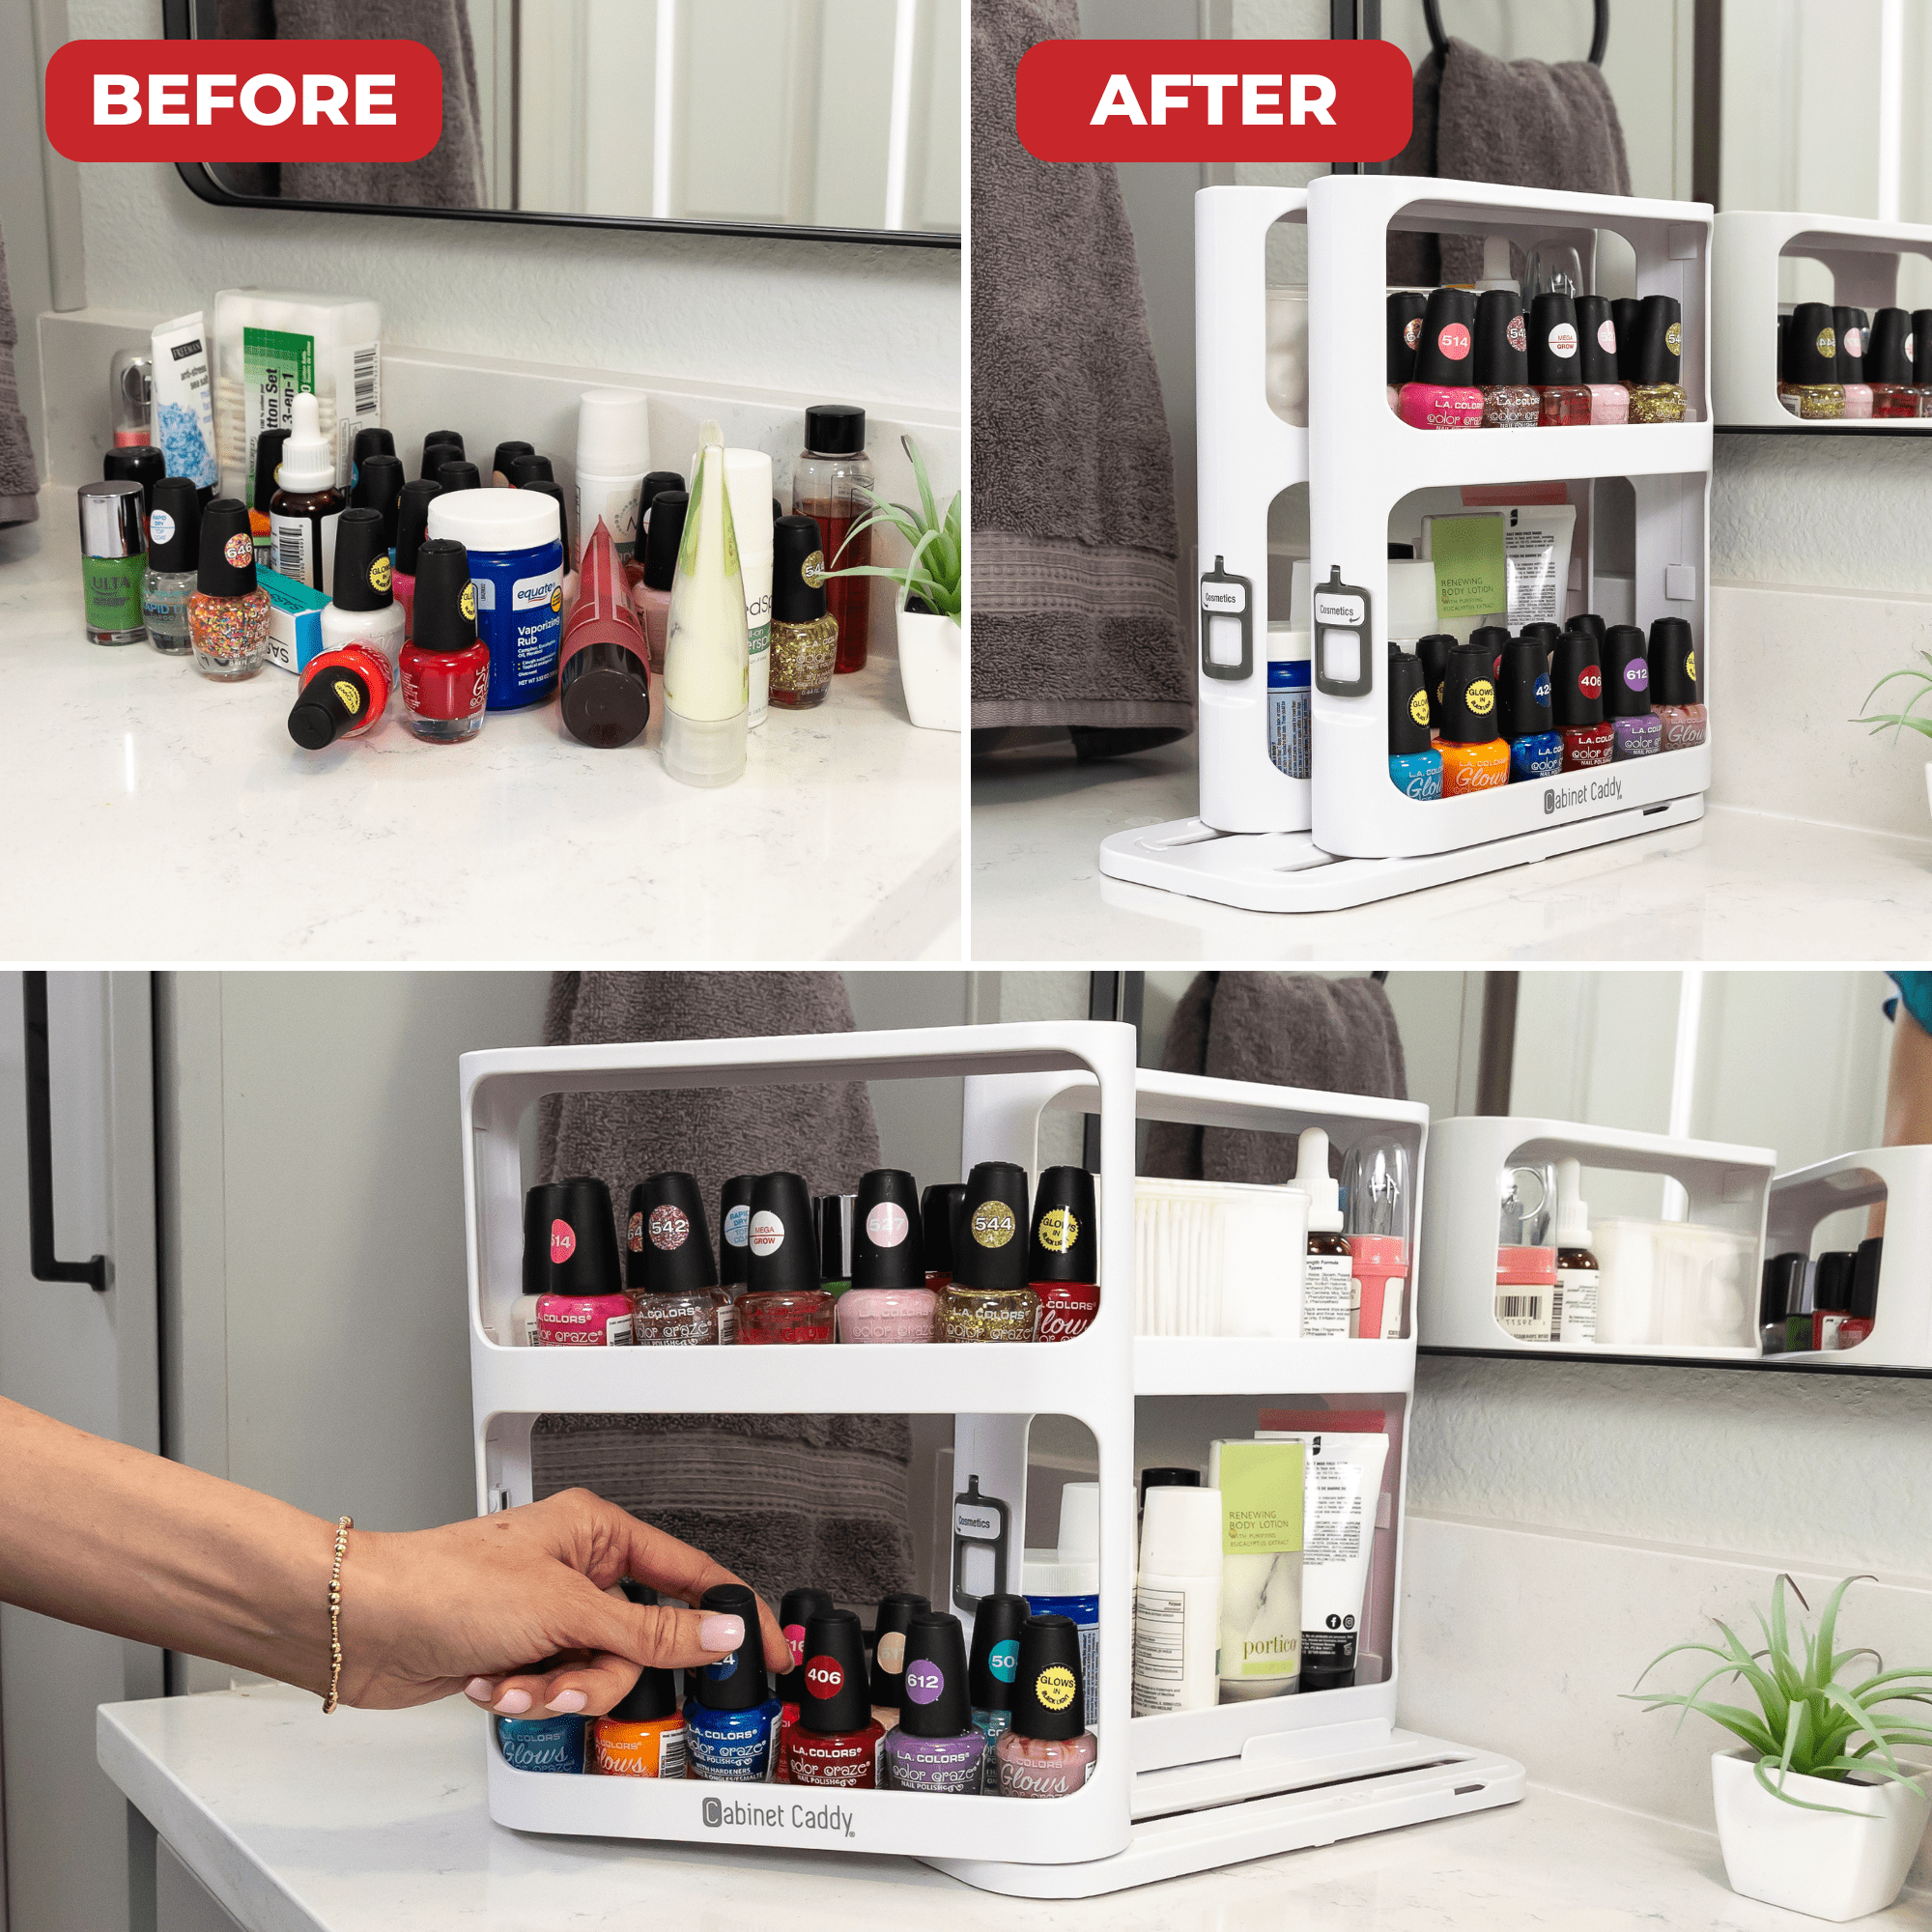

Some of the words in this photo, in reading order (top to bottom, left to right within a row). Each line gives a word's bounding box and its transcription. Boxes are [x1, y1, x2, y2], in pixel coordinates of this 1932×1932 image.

[1442, 335, 1468, 347] 514
[266, 368, 278, 394] Set
[1435, 400, 1452, 409] L.A.
[226, 542, 252, 558] 646
[93, 577, 130, 590] ULTA
[1441, 578, 1483, 586] RENEWING
[518, 582, 554, 600] equate
[1442, 587, 1464, 596] BODY
[1468, 585, 1493, 594] LOTION
[1206, 592, 1236, 604] Cosmetics
[1320, 604, 1353, 616] Cosmetics
[518, 616, 560, 636] Vaporizing
[518, 636, 538, 646] Rub
[1626, 668, 1647, 680] 612
[1581, 675, 1602, 687] 406
[1544, 785, 1587, 814] Cabinet
[1591, 777, 1622, 801] Caddy
[652, 1220, 689, 1235] 542
[975, 1217, 1013, 1231] 544
[1043, 1218, 1076, 1232] GLOS
[1047, 1300, 1094, 1310] COLORS
[544, 1315, 586, 1323] COLORS
[648, 1308, 696, 1319] COLORS
[953, 1307, 973, 1317] L.A.
[976, 1307, 1025, 1320] COLORS
[1229, 1511, 1277, 1520] RENEWING
[958, 1516, 990, 1528] Cosmetics
[1230, 1520, 1256, 1530] BODY
[1259, 1520, 1290, 1529] LOTION
[1243, 1634, 1297, 1660] portico
[808, 1668, 842, 1684] 406
[907, 1673, 939, 1689] 612
[1040, 1675, 1074, 1688] GLOWS
[705, 1730, 753, 1740] COLORS
[503, 1741, 568, 1765] Glows
[792, 1745, 809, 1755] L.A.
[810, 1748, 857, 1757] COLORS
[896, 1750, 915, 1761] L.A.
[917, 1753, 965, 1763] COLORS
[1016, 1758, 1063, 1768] COLORS
[1001, 1763, 1069, 1793] Glows
[702, 1797, 784, 1828] Cabinet
[792, 1804, 853, 1837] Caddy
